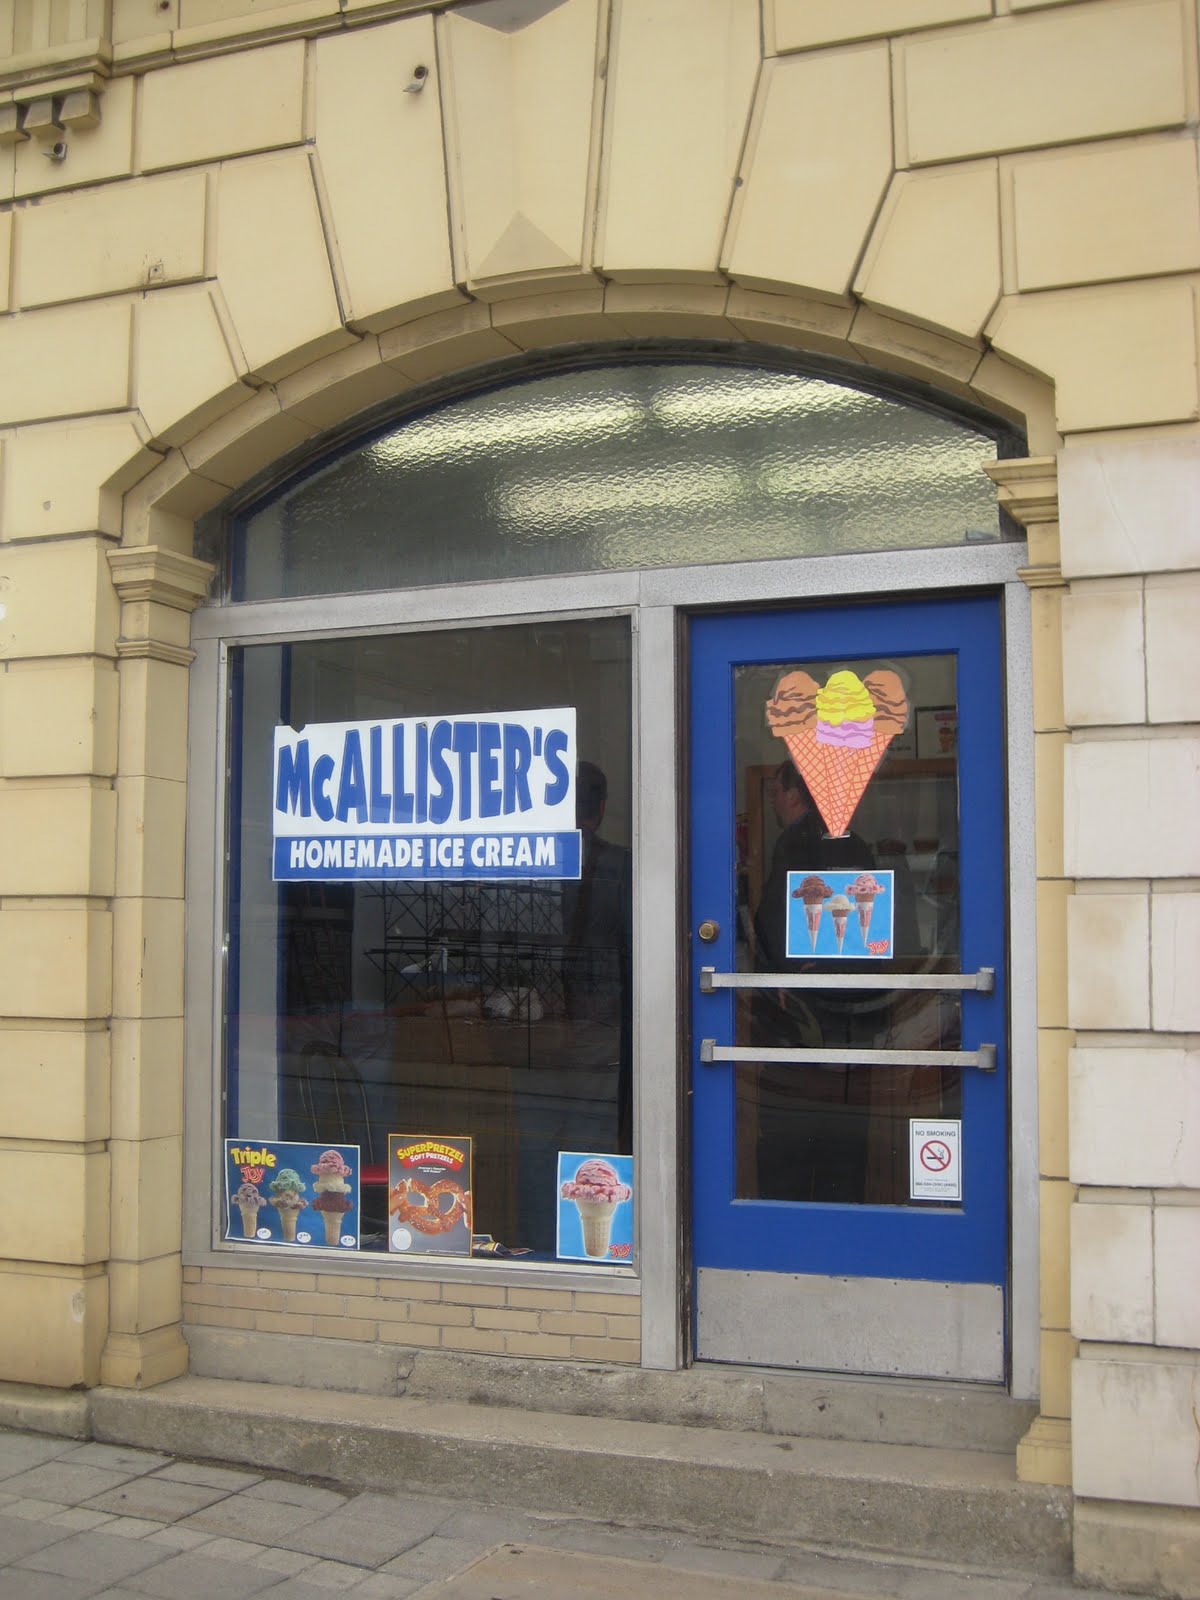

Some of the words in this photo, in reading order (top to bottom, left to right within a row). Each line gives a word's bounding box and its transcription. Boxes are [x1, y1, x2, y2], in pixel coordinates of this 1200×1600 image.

[289, 837, 424, 869] HOMEMADE
[429, 837, 465, 868] ICE
[470, 836, 556, 867] CREAM
[230, 1146, 276, 1167] Triple
[409, 1153, 425, 1163] SOFT
